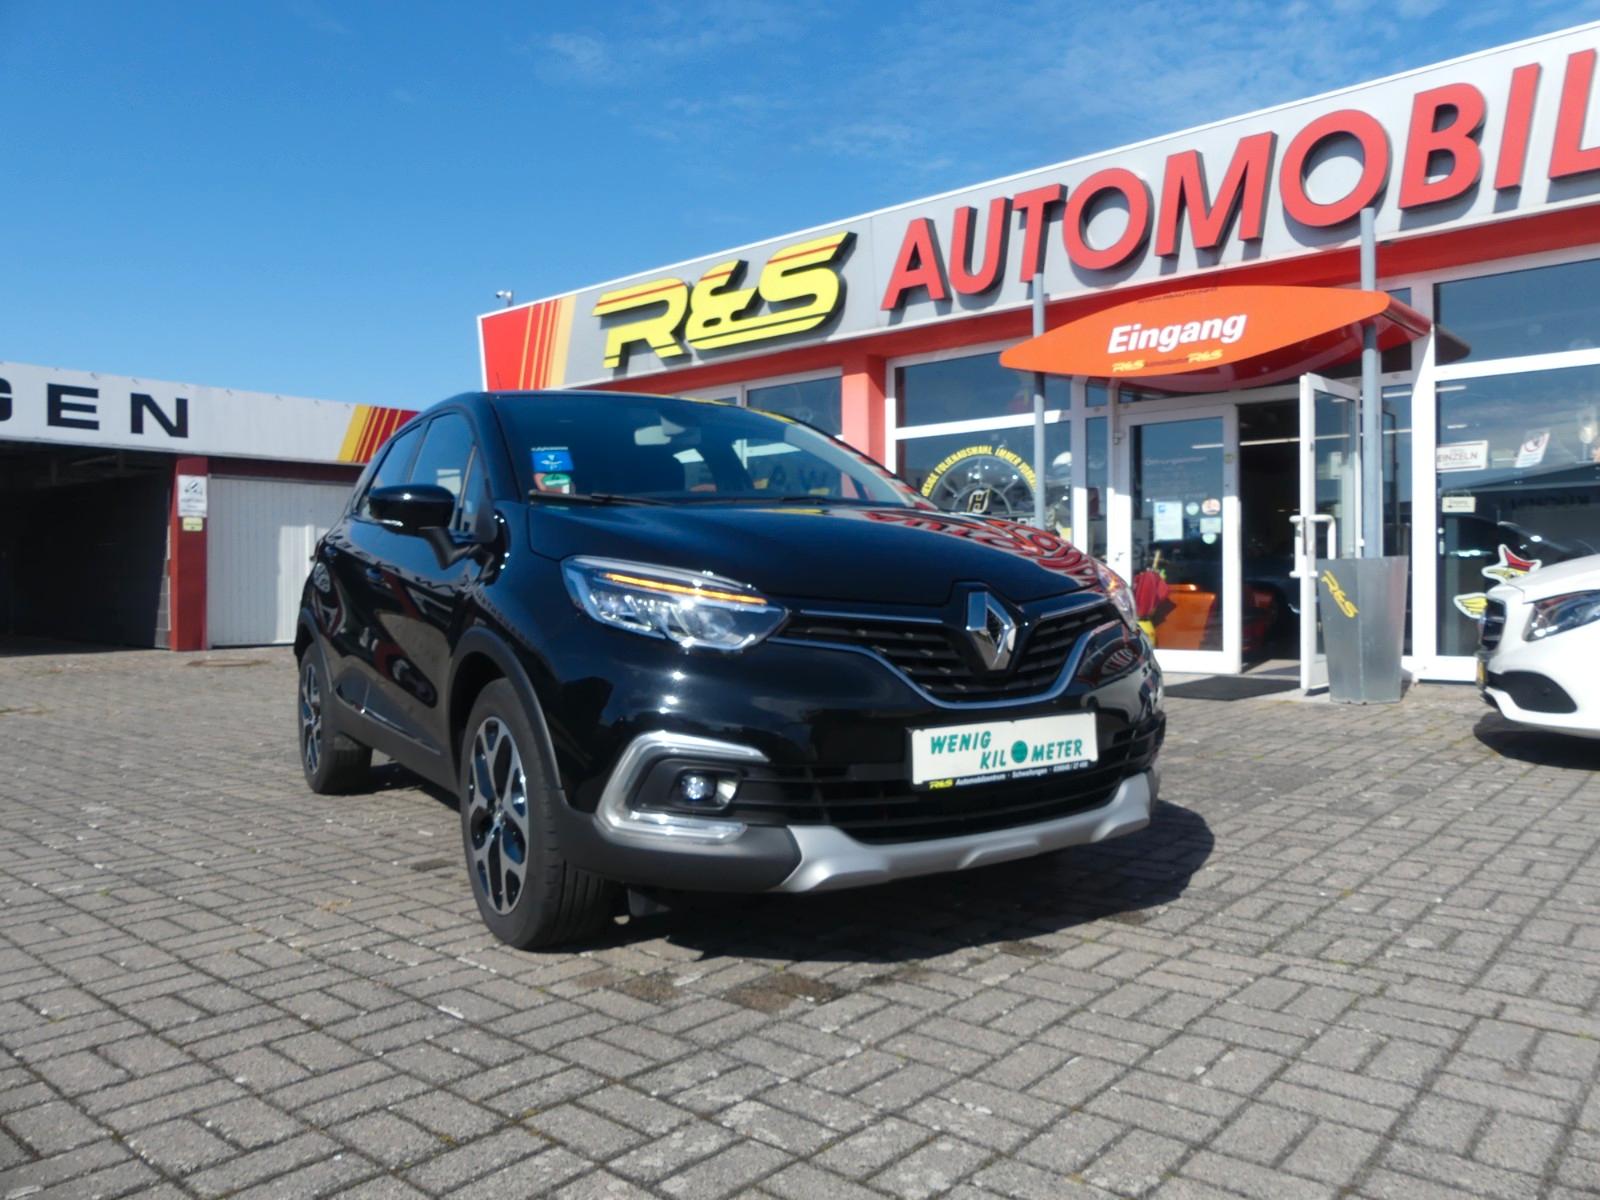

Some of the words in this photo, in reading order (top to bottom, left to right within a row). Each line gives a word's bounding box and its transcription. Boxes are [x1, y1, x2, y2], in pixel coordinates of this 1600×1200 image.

[592, 231, 850, 369] R&S
[880, 48, 1600, 310] AUTOMOBIL
[1108, 313, 1248, 354] Eingang
[0, 377, 189, 439] EN
[930, 730, 992, 755] WENIG
